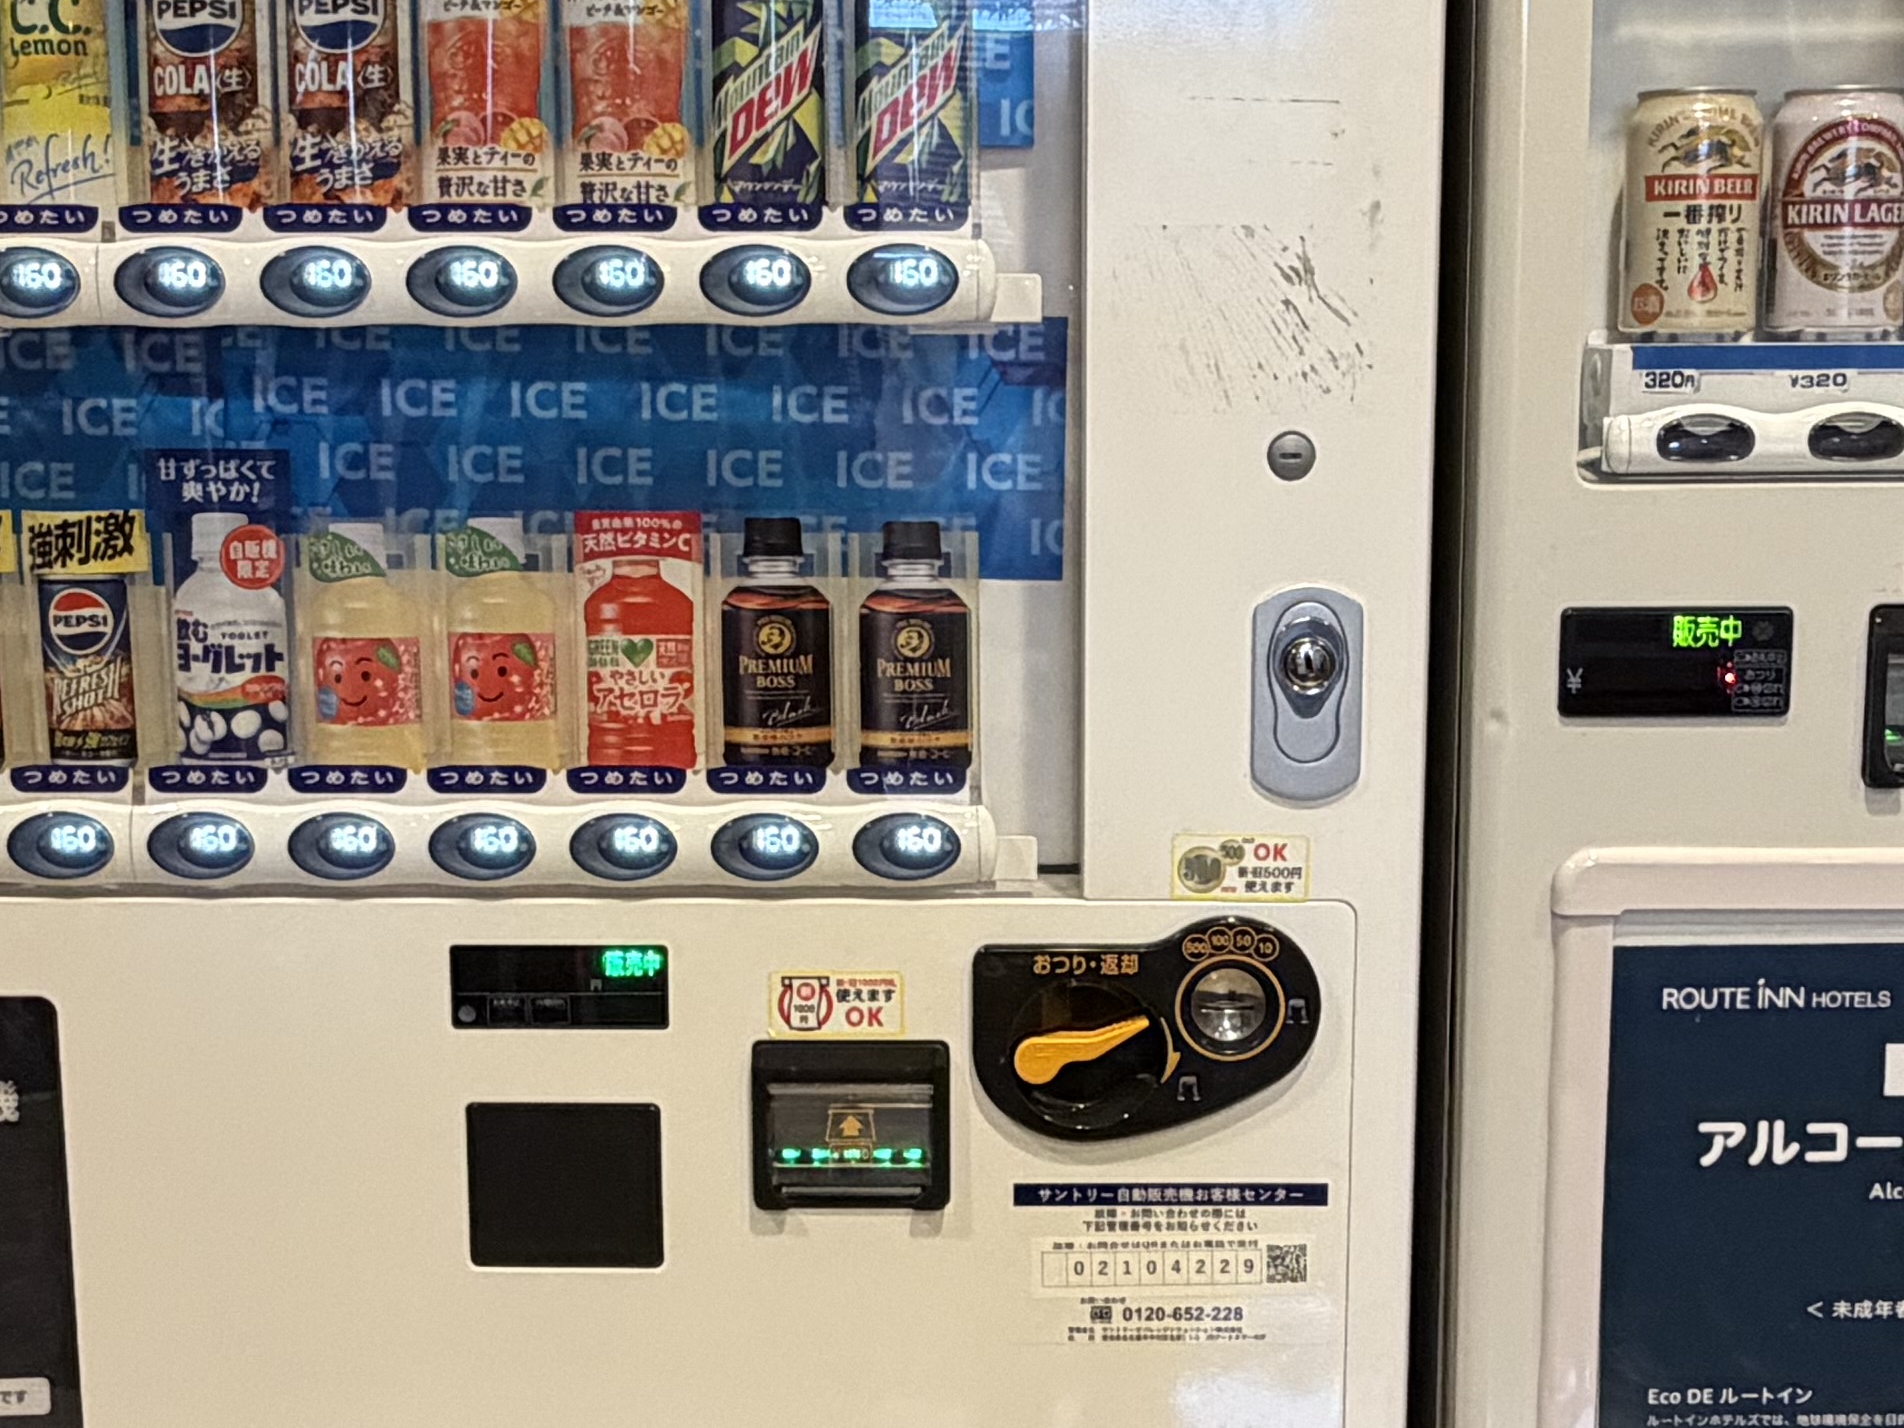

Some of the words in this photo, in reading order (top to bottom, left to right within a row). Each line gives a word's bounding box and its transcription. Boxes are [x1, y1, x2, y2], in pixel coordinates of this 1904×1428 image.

[296, 62, 353, 94] COLA
[726, 42, 812, 162] DEW
[436, 145, 536, 168] 果実とティーの
[438, 174, 527, 201] 贅沢な甘さ
[1653, 179, 1709, 196] KIRIN
[1713, 179, 1754, 195] BEER
[566, 208, 663, 223] つめたい
[1662, 203, 1742, 225] 一番搾り
[1787, 202, 1850, 225] KIRIN
[1644, 373, 1694, 390] 320円
[381, 377, 458, 418] ICE
[319, 442, 396, 483] ICE
[181, 481, 260, 504] 爽やか!
[583, 531, 691, 553] 天然ビタミンC
[1672, 614, 1743, 648] 販売中
[738, 653, 814, 675] PREMIUM
[755, 675, 796, 690] BOSS
[595, 684, 692, 713] アセロラ
[580, 771, 673, 786] つめたい
[1254, 843, 1289, 863] OK
[604, 950, 662, 977] 販売中
[1033, 954, 1139, 976] おつり・返却
[836, 988, 896, 1004] 使えます
[1662, 987, 1752, 1010] ROUTE
[1811, 990, 1892, 1009] HOTELS
[845, 1005, 885, 1028] OK
[1037, 1187, 1304, 1204] サントリー自動販売機お客様センター
[1122, 1306, 1244, 1323] 0120-652-228
[1647, 1387, 1682, 1405] Eco
[1687, 1386, 1714, 1405] DE
[1718, 1385, 1814, 1406] ルートイン
